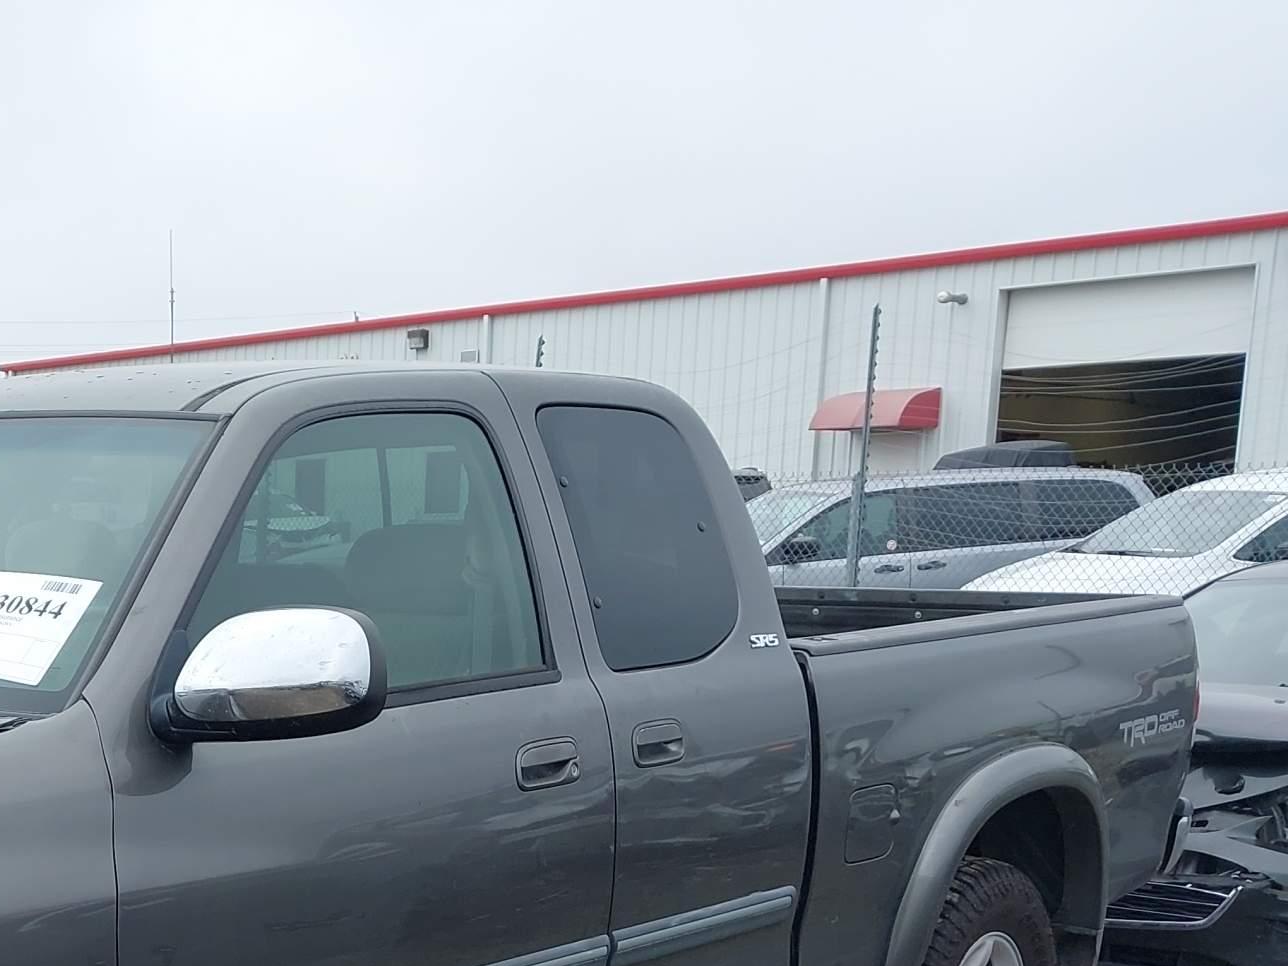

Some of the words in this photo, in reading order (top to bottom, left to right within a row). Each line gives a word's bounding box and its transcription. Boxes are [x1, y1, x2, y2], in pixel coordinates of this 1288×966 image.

[750, 633, 779, 648] SR5
[1159, 708, 1180, 722] OFF
[1119, 714, 1158, 748] TRD
[1158, 718, 1186, 734] ROAD
